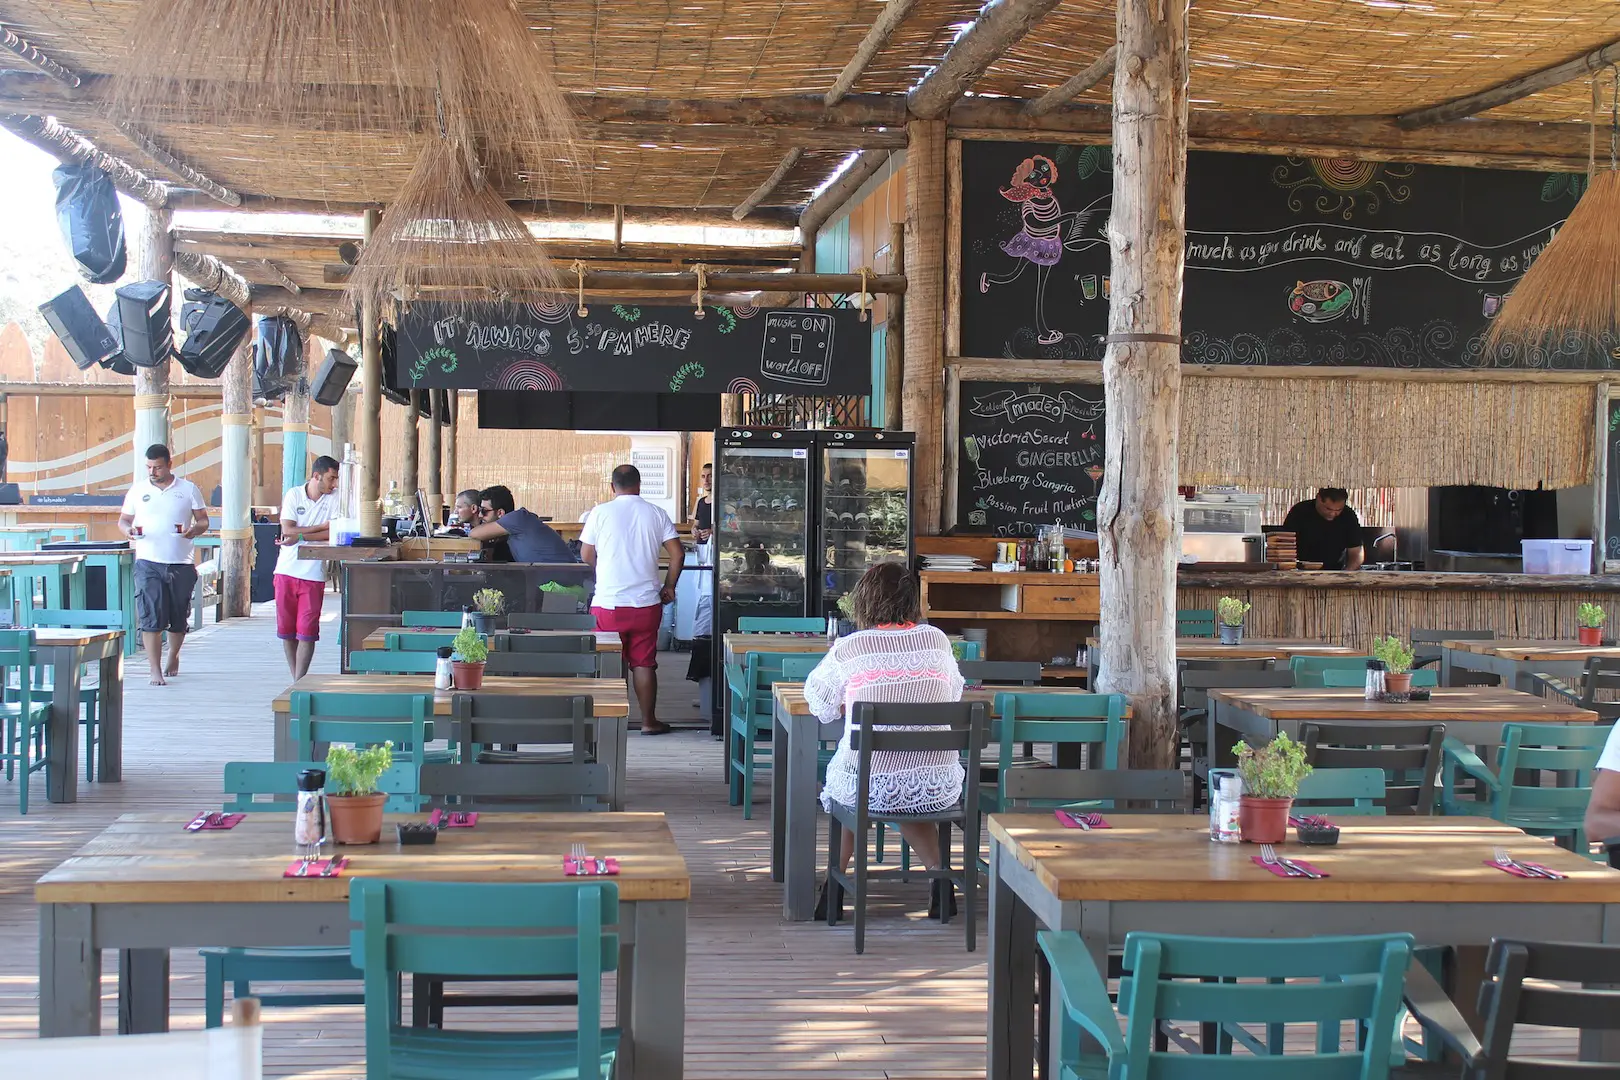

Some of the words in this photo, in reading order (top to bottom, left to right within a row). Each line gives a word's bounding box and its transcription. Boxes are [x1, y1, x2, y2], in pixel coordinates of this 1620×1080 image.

[1186, 235, 1235, 260] much
[1240, 245, 1256, 261] as
[1258, 242, 1280, 265] you
[1283, 229, 1327, 252] drink
[1334, 234, 1367, 258] and
[1370, 236, 1405, 261] eat
[1419, 243, 1441, 262] as
[1449, 243, 1492, 279] long
[1500, 255, 1518, 273] as
[767, 316, 797, 329] music
[801, 317, 826, 333] ON
[465, 321, 552, 355] ALWAYS
[765, 358, 799, 374] world
[799, 361, 823, 377] OFF
[977, 428, 1029, 449] Victoria
[1026, 428, 1069, 445] Secret
[1016, 444, 1102, 468] GINGERELLA
[973, 466, 1030, 491] Blueberry
[1032, 472, 1077, 495] Sangria
[986, 494, 1018, 515] Passion
[1022, 500, 1049, 515] Fruit
[1053, 494, 1088, 514] Martini
